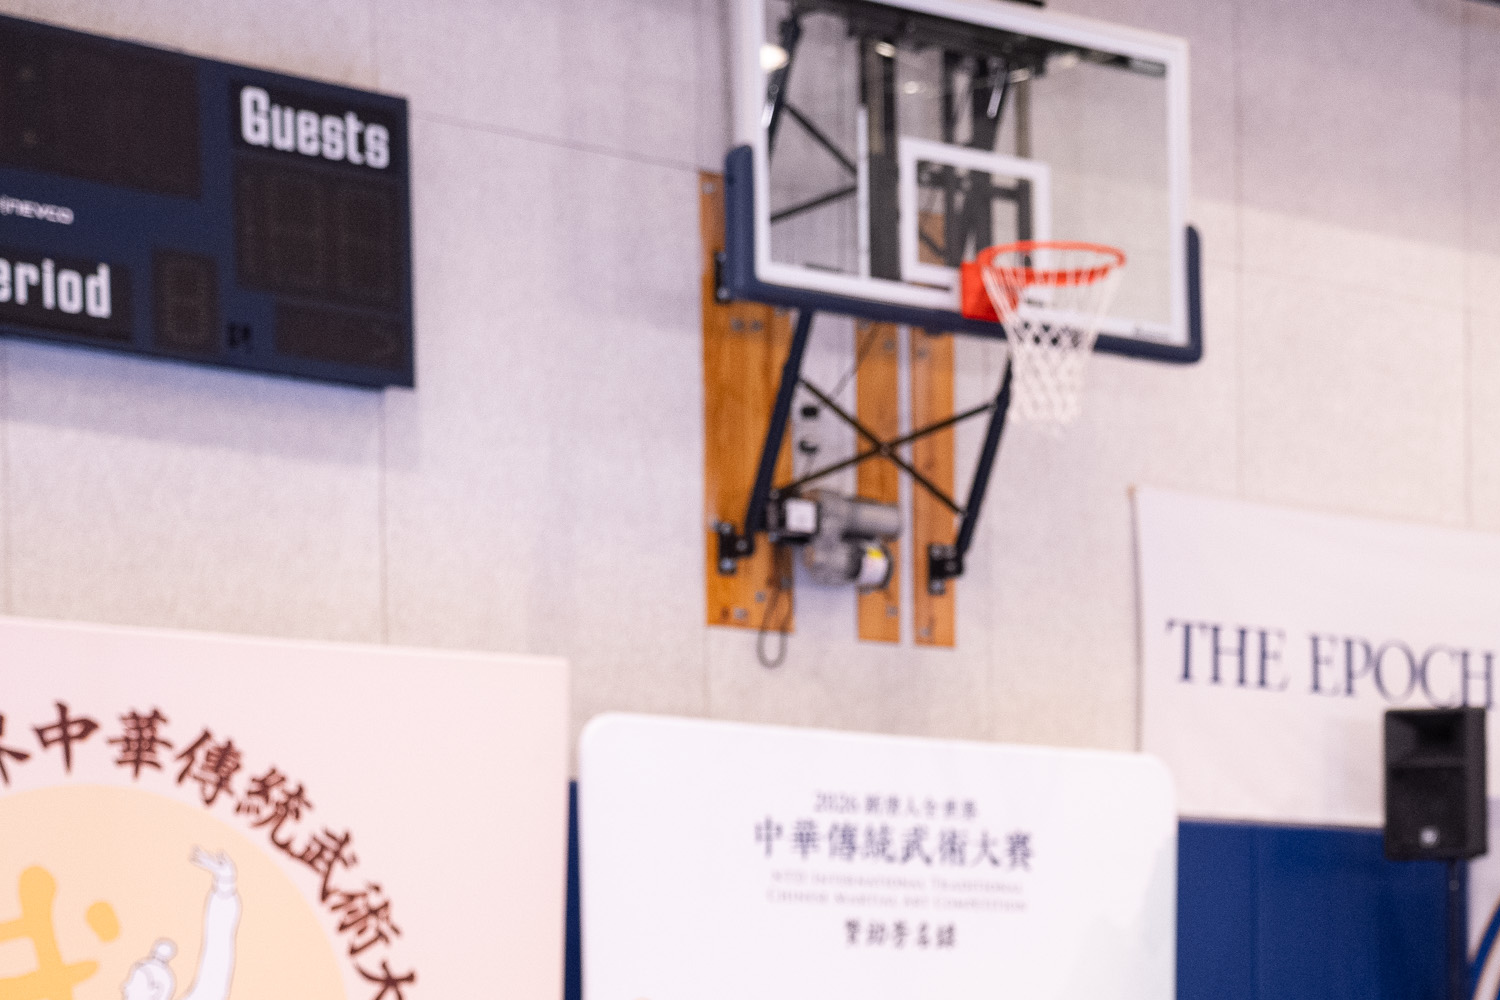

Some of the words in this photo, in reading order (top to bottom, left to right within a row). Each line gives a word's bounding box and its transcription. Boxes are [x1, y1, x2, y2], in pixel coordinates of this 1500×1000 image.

[239, 85, 391, 169] Guests
[1165, 617, 1290, 692] THE
[1306, 632, 1496, 713] EPOCH
[754, 815, 1034, 871] 中華傳統武術大賽
